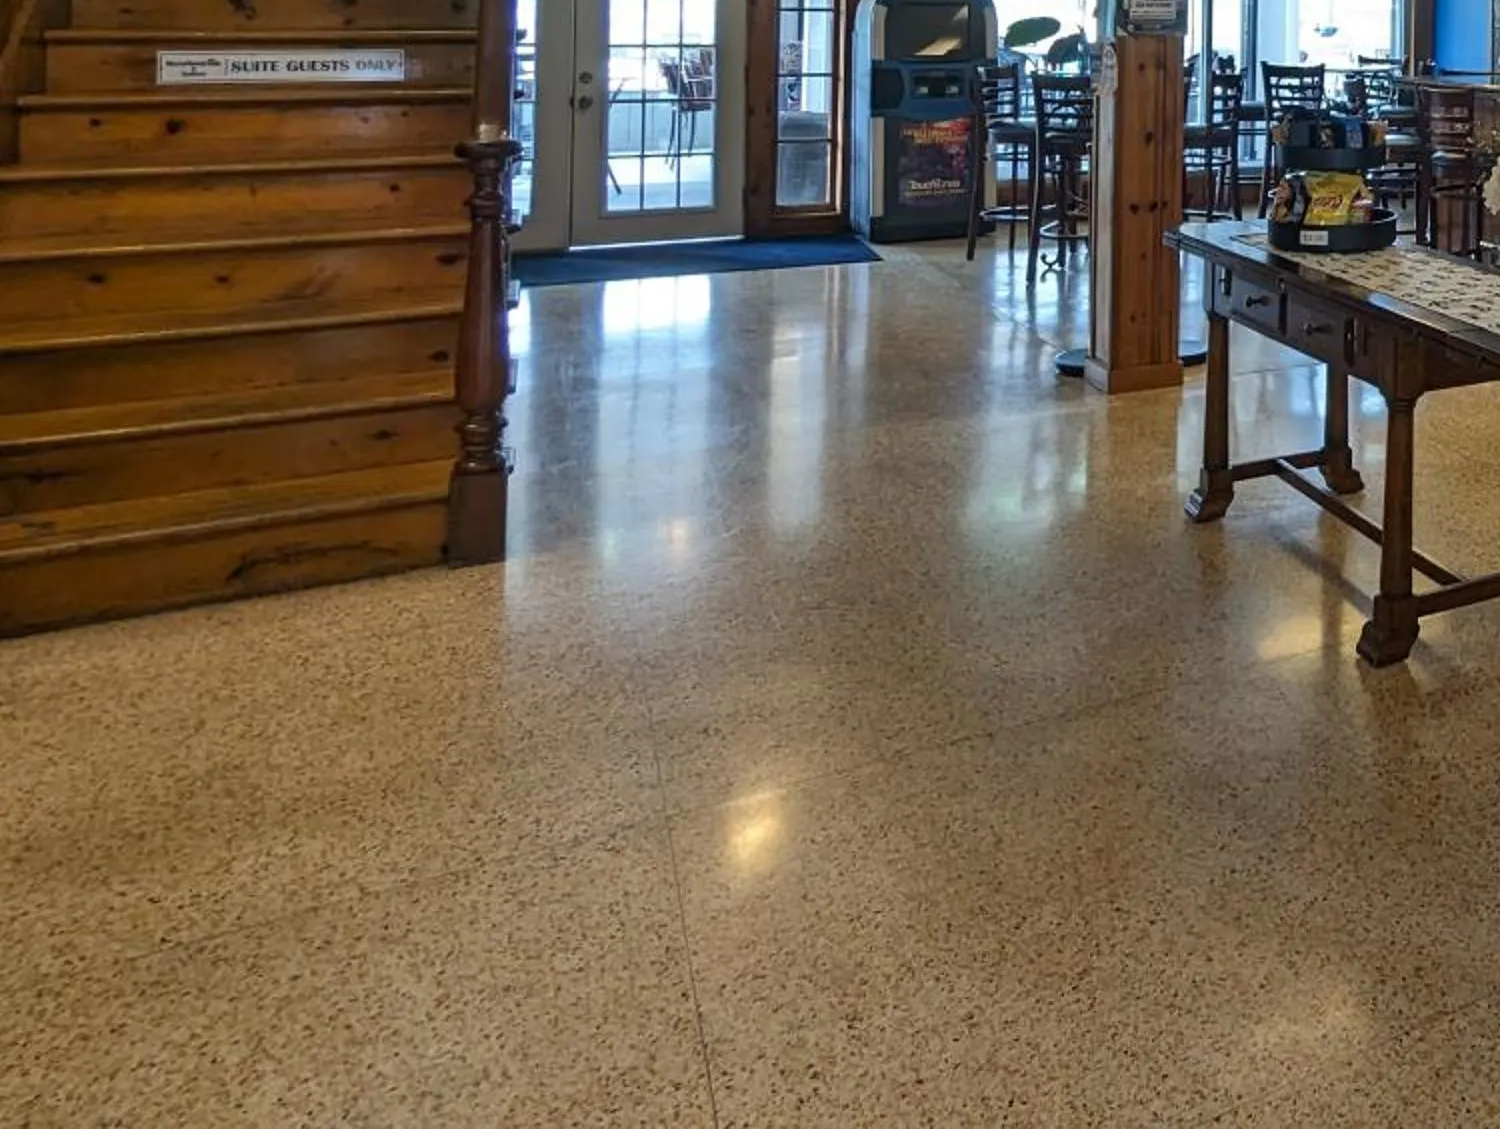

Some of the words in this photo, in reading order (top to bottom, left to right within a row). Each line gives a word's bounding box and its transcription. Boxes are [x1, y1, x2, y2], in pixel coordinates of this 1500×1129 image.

[231, 59, 280, 72] SUITE
[286, 59, 350, 72] GUESTS
[355, 59, 396, 71] ONLY
